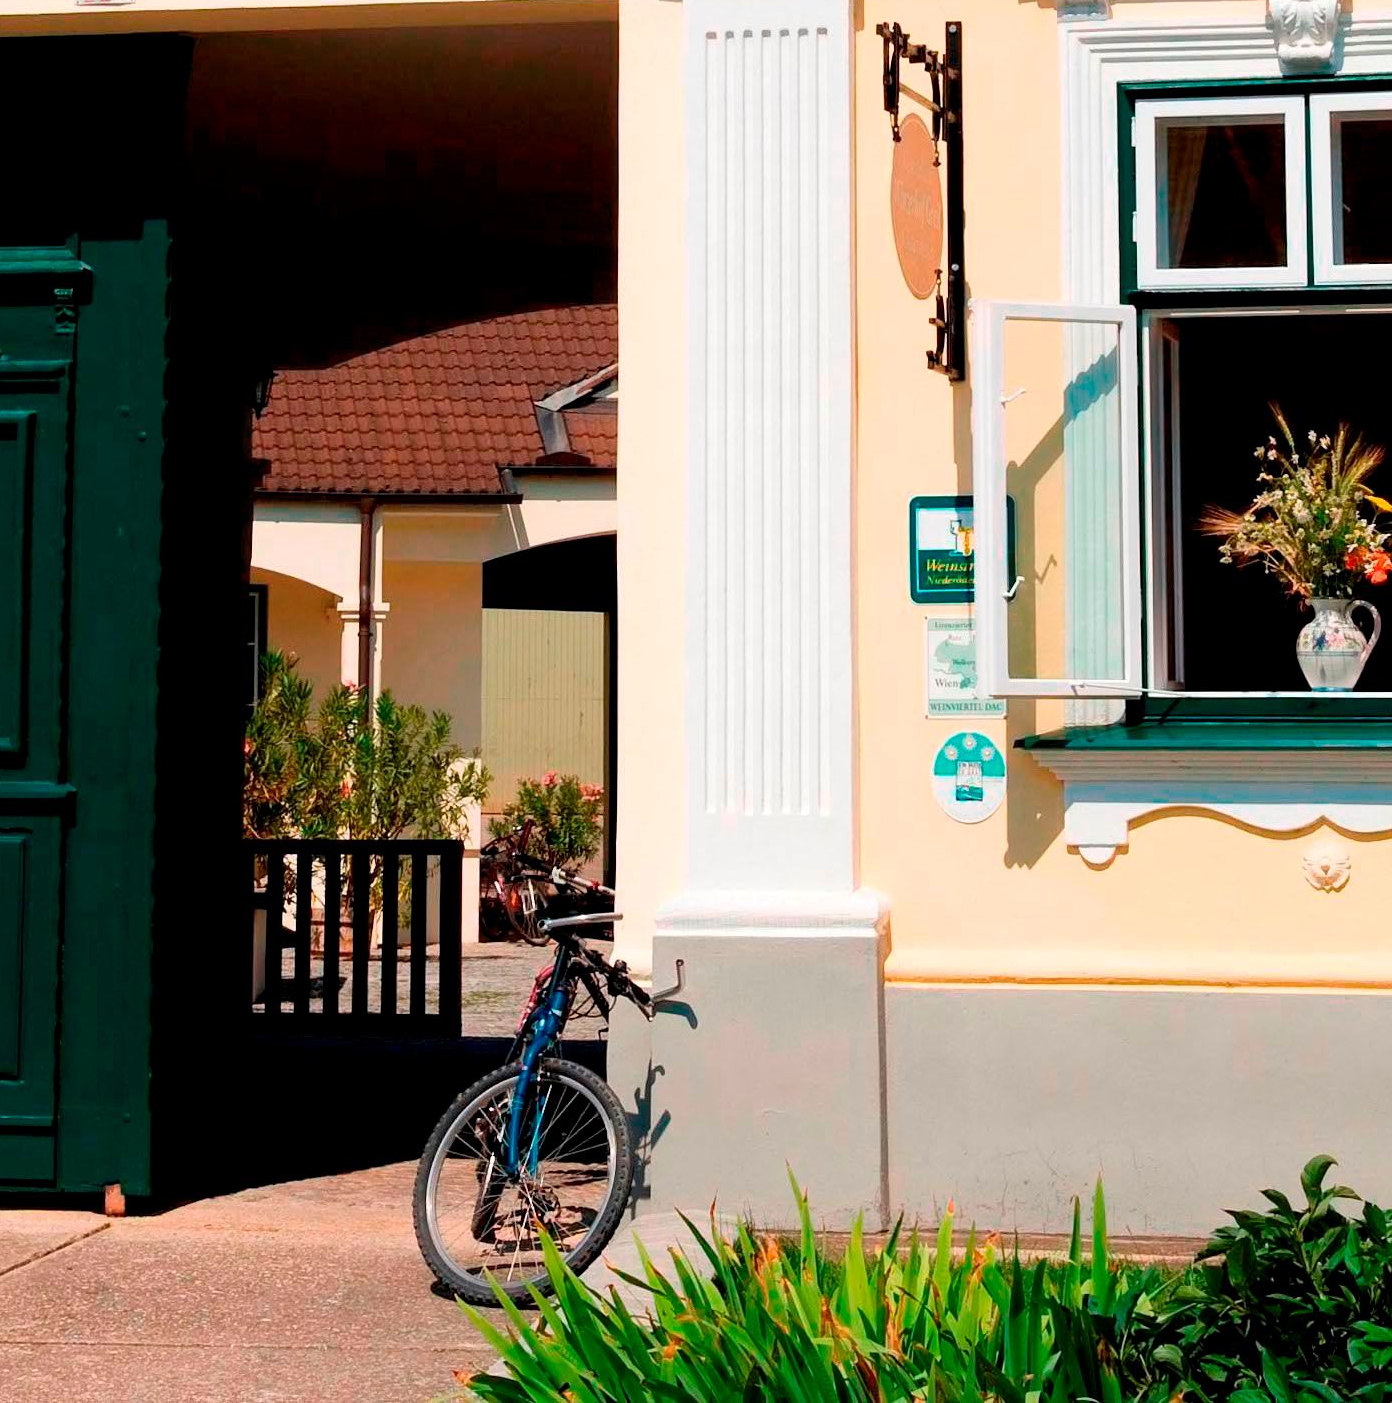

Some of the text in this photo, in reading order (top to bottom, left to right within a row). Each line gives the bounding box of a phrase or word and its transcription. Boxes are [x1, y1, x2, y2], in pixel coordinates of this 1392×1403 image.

[935, 678, 958, 688] Wien
[930, 702, 1002, 711] WEINVIERTEL DAC
